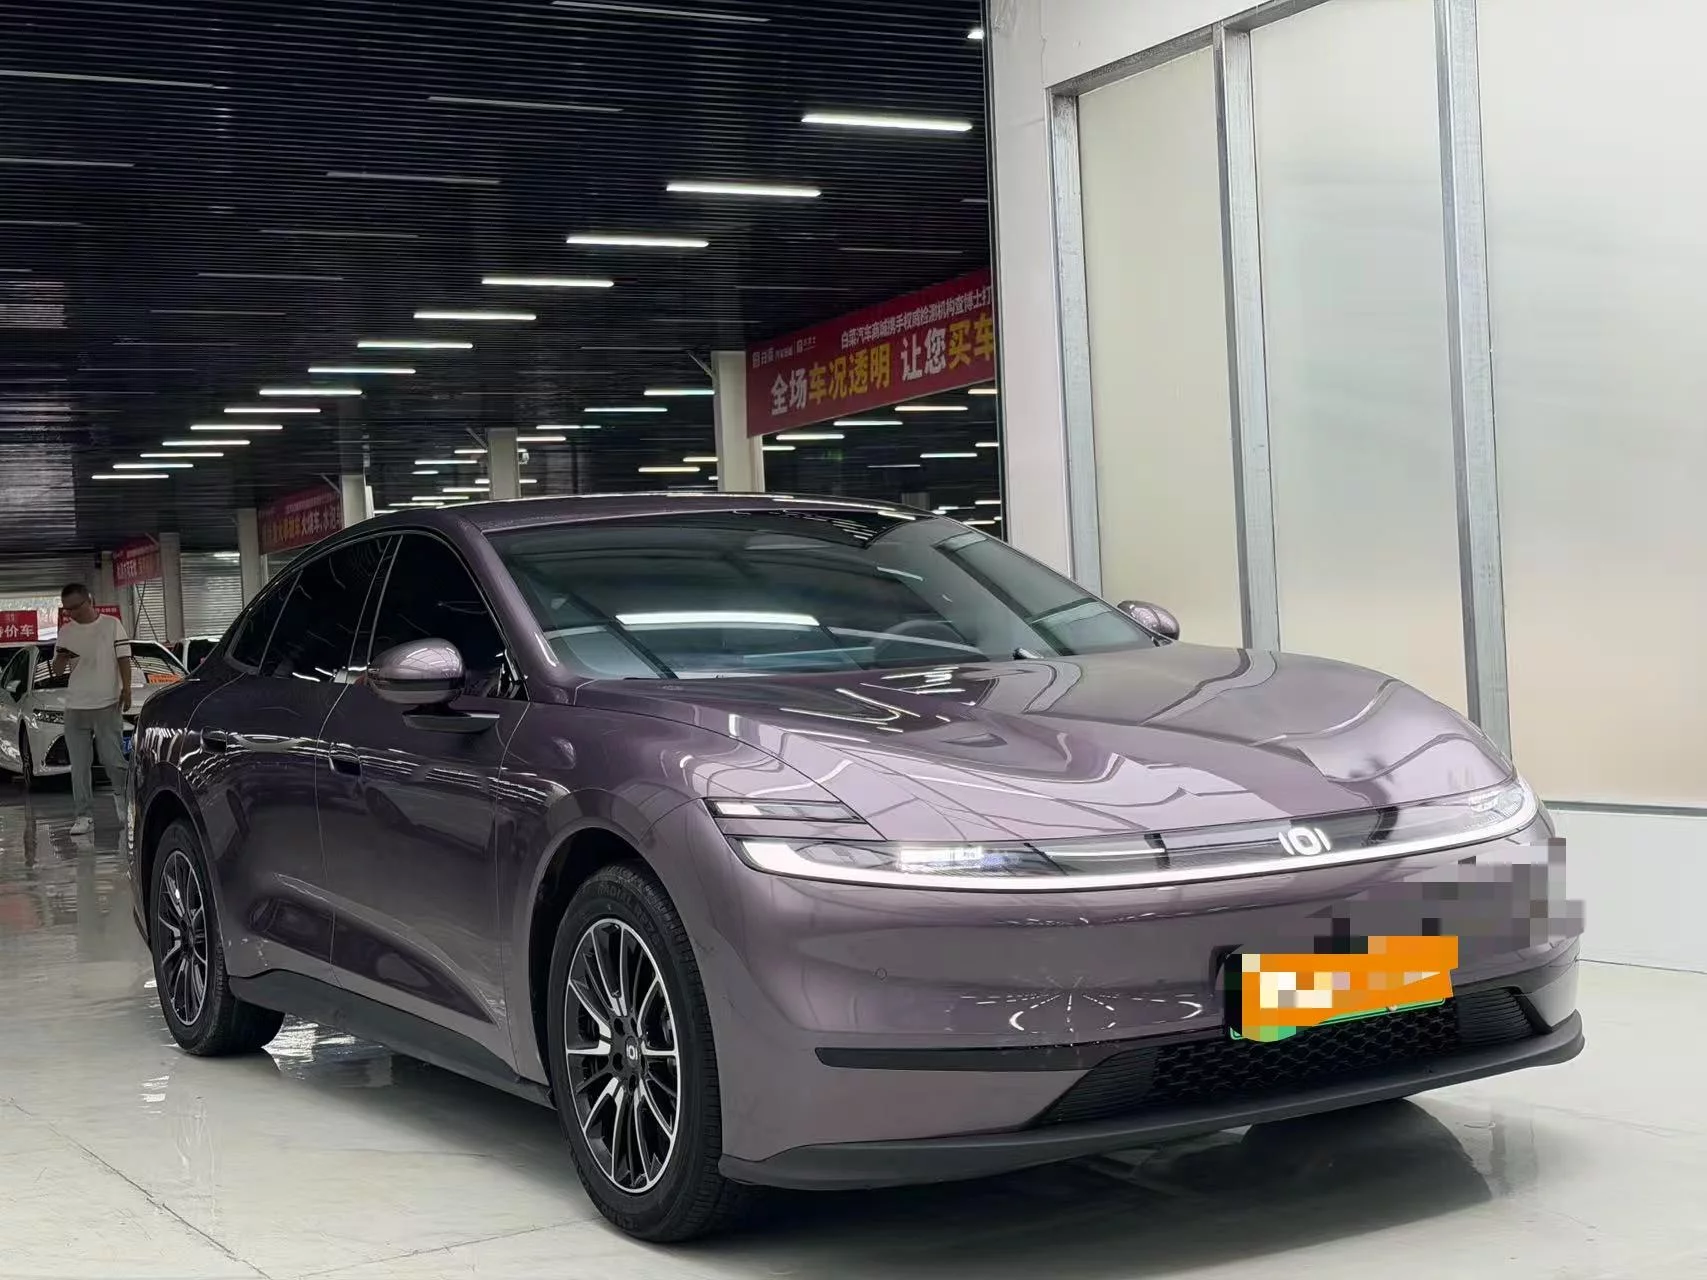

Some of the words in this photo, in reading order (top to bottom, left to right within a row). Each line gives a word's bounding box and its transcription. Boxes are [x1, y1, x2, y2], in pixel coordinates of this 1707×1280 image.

[770, 342, 892, 416] 全场车况透明
[900, 311, 994, 382] 让您买车
[0, 624, 35, 638] 价车
